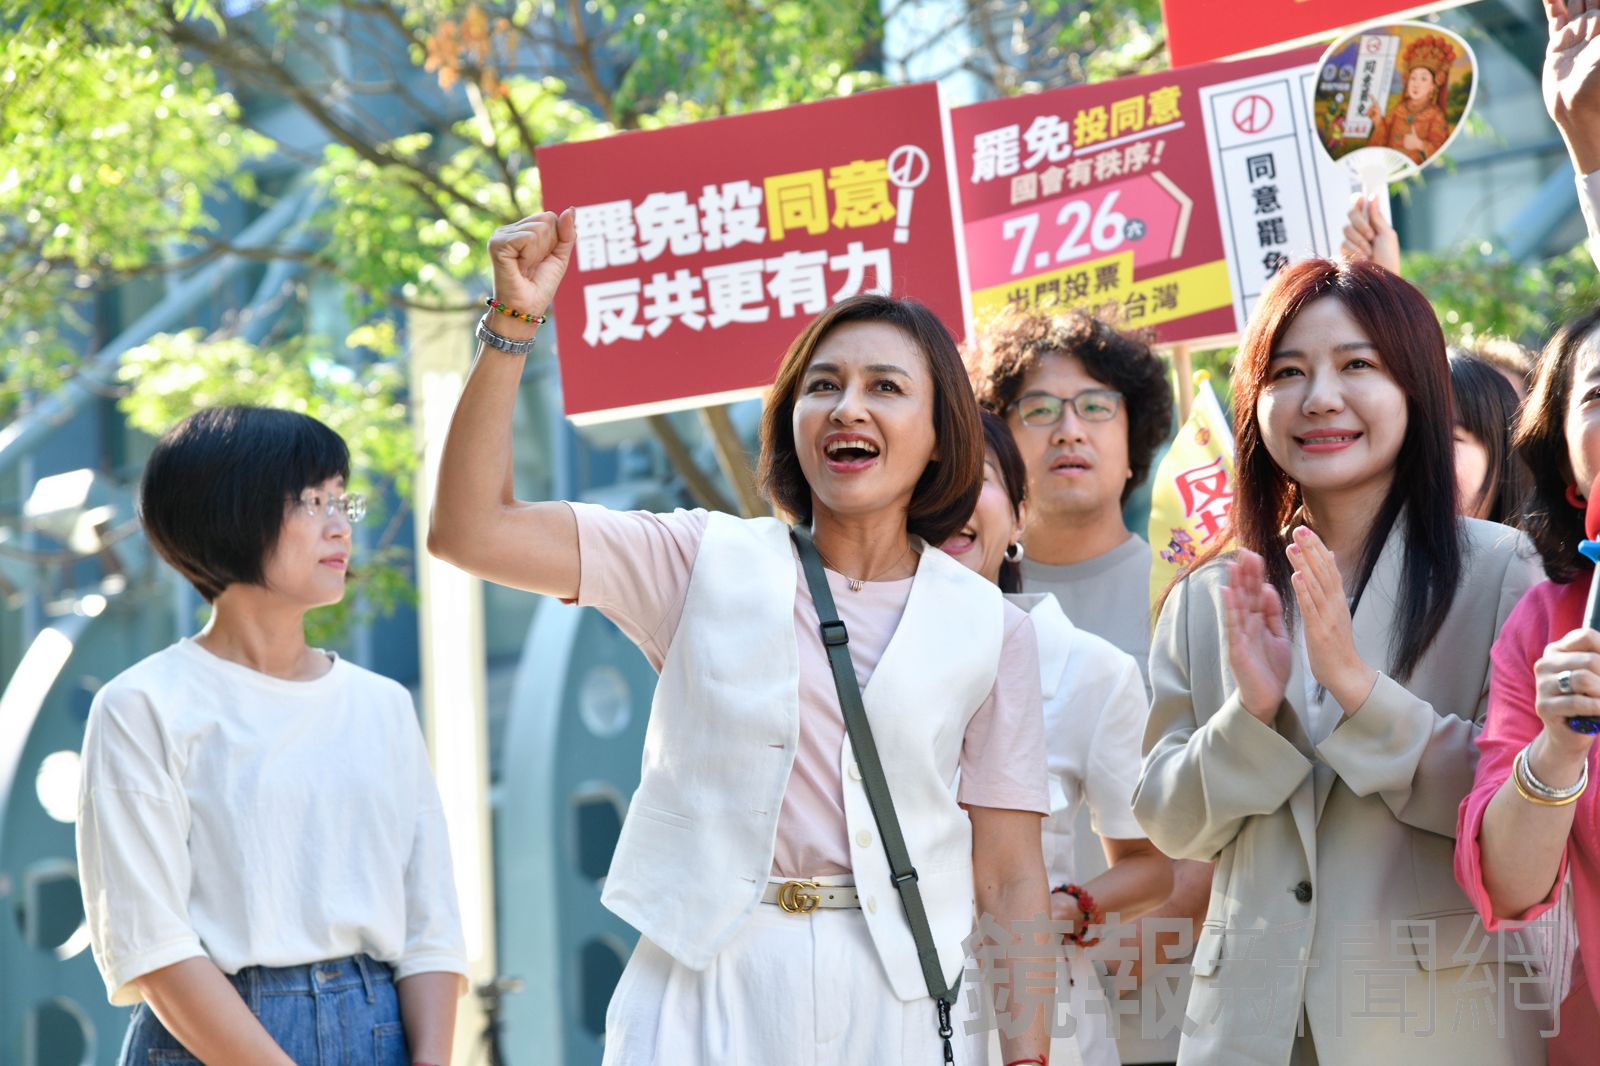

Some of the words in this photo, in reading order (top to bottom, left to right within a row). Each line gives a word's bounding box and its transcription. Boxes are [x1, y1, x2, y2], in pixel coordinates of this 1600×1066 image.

[970, 85, 1182, 184] 罷免投同意
[1002, 190, 1128, 275] 7.26
[581, 240, 893, 348] 反共更有力
